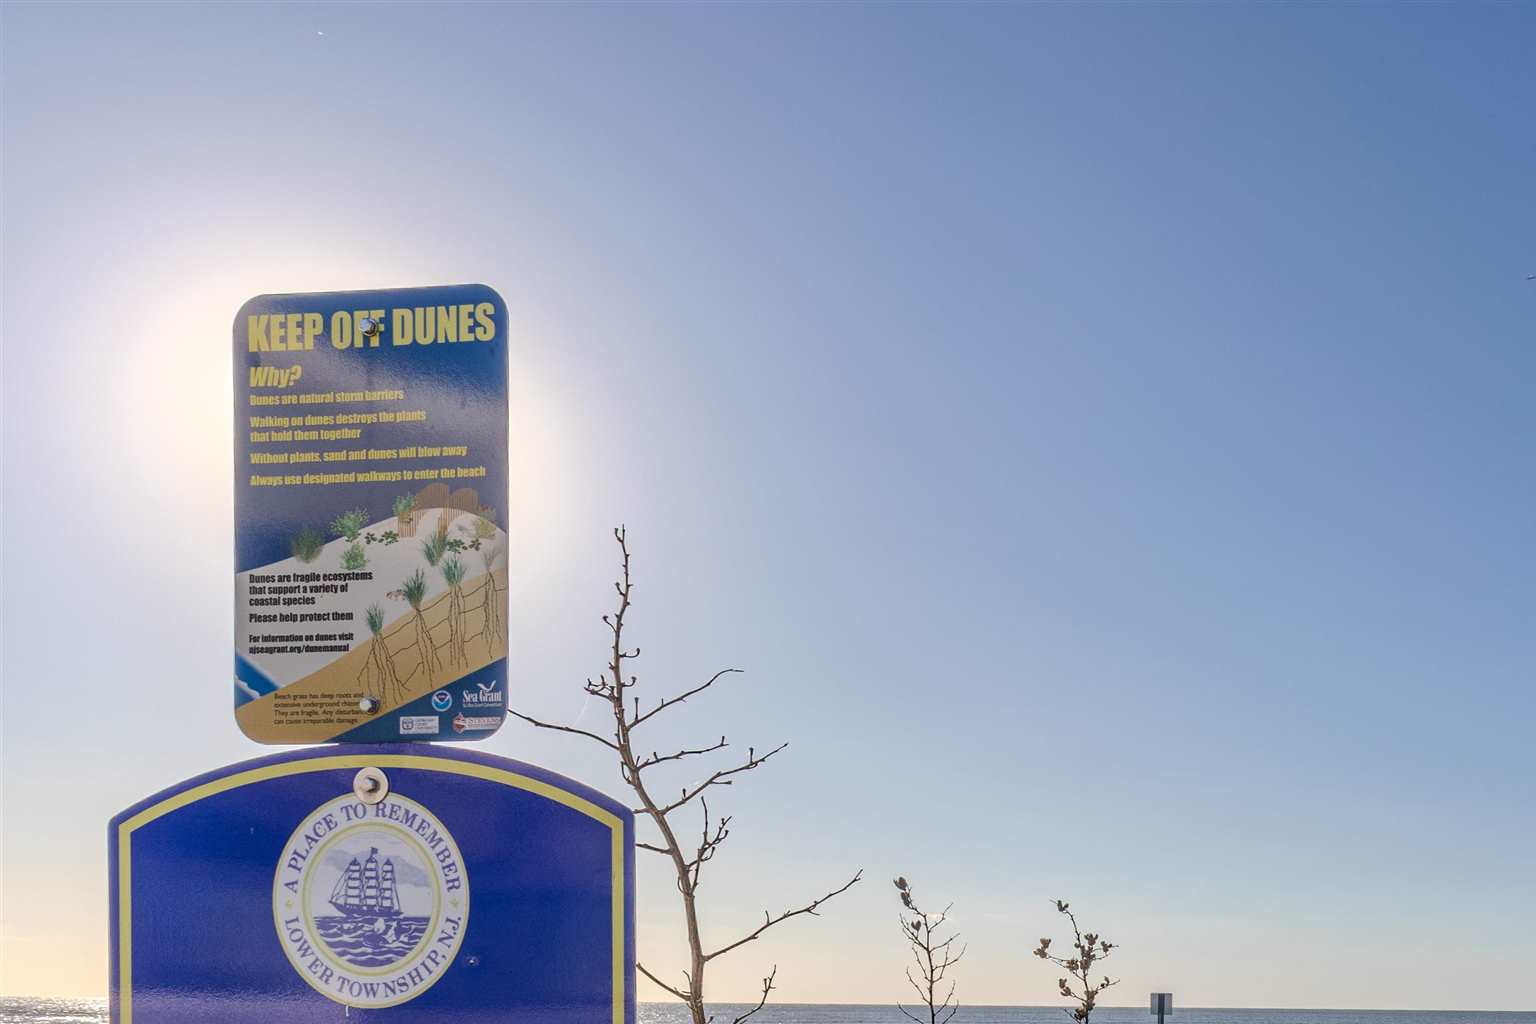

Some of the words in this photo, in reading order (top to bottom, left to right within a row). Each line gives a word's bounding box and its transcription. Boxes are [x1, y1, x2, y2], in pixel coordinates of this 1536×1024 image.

[247, 312, 324, 353] KEEP
[331, 309, 385, 350] OFF
[392, 302, 496, 346] DUNES
[250, 365, 302, 388] Why?
[250, 395, 280, 406] Dunes
[281, 395, 298, 405] are
[299, 392, 334, 404] natural
[335, 392, 363, 402] storm
[365, 390, 404, 401] barriers
[250, 416, 289, 428] Walking
[291, 416, 303, 426] on
[304, 414, 334, 425] dunes
[336, 413, 377, 424] destroys
[379, 411, 395, 422] the
[396, 409, 426, 422] plants
[250, 431, 269, 442] that
[271, 430, 292, 442] hold
[294, 430, 318, 440] them
[320, 428, 361, 440] together
[250, 452, 288, 464] Without
[323, 450, 347, 461] sand
[348, 449, 366, 460] and
[368, 448, 397, 460] dunes
[399, 446, 416, 458] will
[418, 446, 441, 457] blow
[442, 446, 467, 457] away
[250, 475, 283, 486] Always
[285, 475, 302, 485] use
[303, 472, 355, 485] designated
[356, 470, 401, 482] walkways
[403, 470, 412, 480] to
[414, 469, 439, 480] enter
[440, 468, 456, 478] the
[457, 465, 486, 477] beach
[249, 574, 276, 584] Dunes
[277, 574, 291, 583] are
[293, 573, 321, 583] fragile
[322, 572, 373, 582] ecosystems
[249, 585, 266, 595] that
[268, 585, 301, 595] support
[302, 585, 308, 593] a
[309, 583, 338, 594] variety
[340, 583, 348, 593] of
[249, 597, 280, 606] coastal
[282, 596, 316, 606] species
[249, 613, 277, 623] Please
[279, 612, 298, 623] help
[300, 612, 330, 622] protect
[332, 611, 353, 621] them
[249, 634, 260, 643] For
[261, 634, 303, 642] information
[305, 634, 314, 642] on
[315, 633, 337, 641] dunes
[339, 633, 354, 641] visit
[249, 644, 350, 655] njseagrant.org/dunemanual
[463, 690, 478, 702] Sea
[480, 690, 502, 702] Grant
[340, 803, 367, 821] TO
[288, 814, 338, 873] PLACE
[375, 803, 461, 892] REMEMBER
[284, 880, 298, 894] A
[285, 917, 336, 985] LOWER
[337, 949, 447, 998] TOWNSHIP,
[438, 916, 462, 949] N.J.
